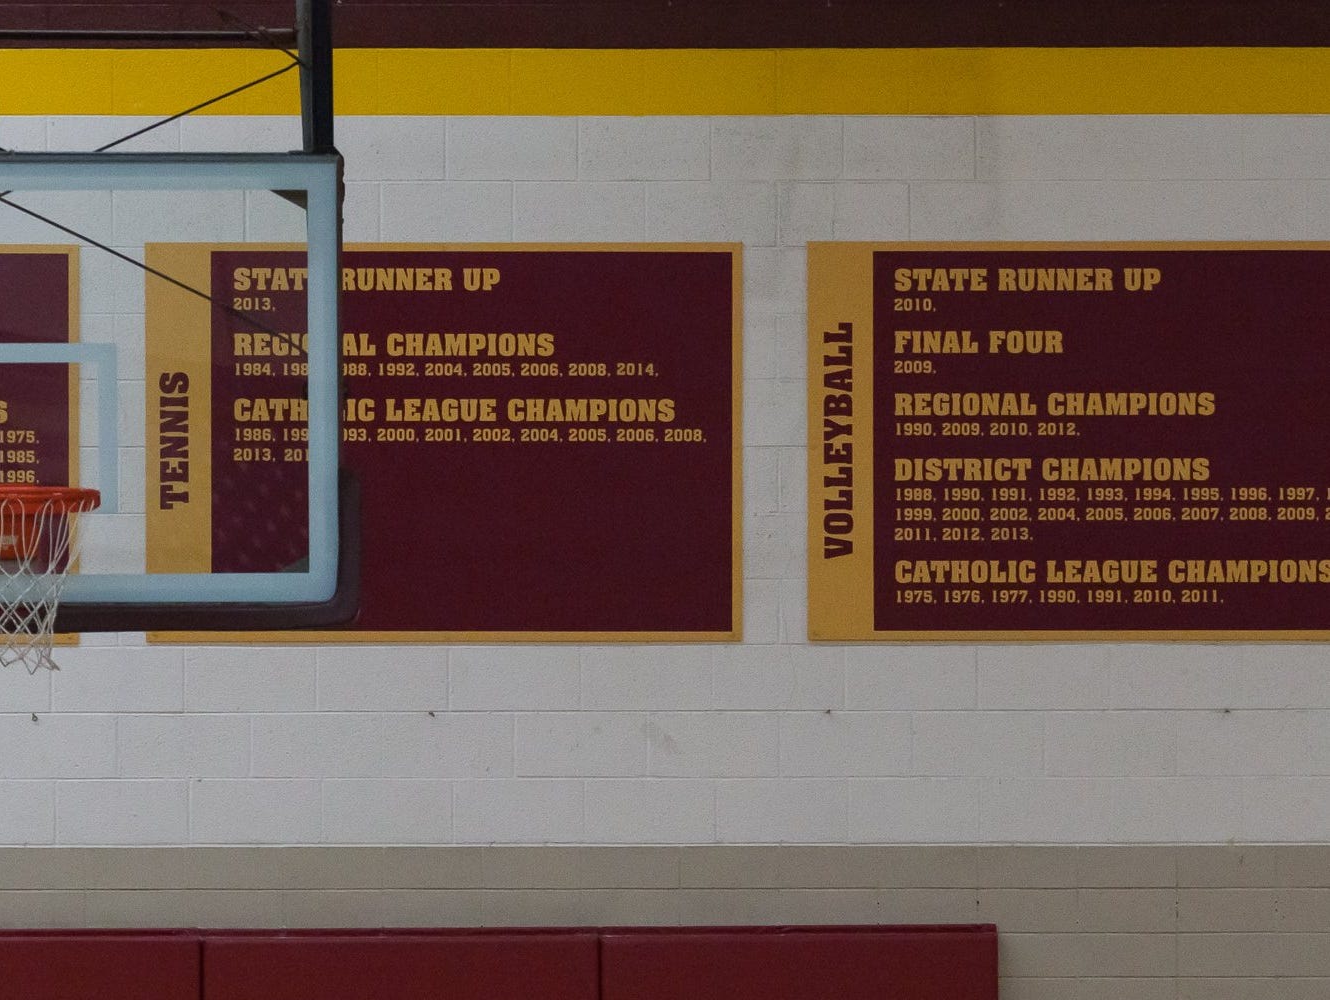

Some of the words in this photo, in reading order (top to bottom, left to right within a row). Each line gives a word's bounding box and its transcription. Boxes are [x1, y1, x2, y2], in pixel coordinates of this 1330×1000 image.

[233, 267, 308, 292] STAT
[342, 267, 453, 292] RUNNER
[462, 267, 501, 292] UP
[894, 267, 988, 292] STATE
[998, 267, 1114, 292] RUNNER
[1123, 267, 1161, 292] UP
[386, 332, 555, 357] CHAMPIONS
[894, 330, 979, 354] FINAL
[989, 330, 1064, 354] FOUR
[385, 398, 497, 423] LEAGUE
[507, 398, 676, 423] CHAMPIONS
[894, 392, 1037, 417] REGIONAL
[1047, 392, 1216, 417] CHAMPIONS
[158, 371, 190, 511] TENNIS
[823, 321, 854, 559] VOLLEYBALL
[894, 457, 1032, 482] DISTRICT
[1042, 457, 1210, 482] CHAMPIONS
[894, 559, 1036, 584] CATHOLIC
[1046, 559, 1158, 584] LEAGUE
[1168, 559, 1330, 584] CHAMPIONS
